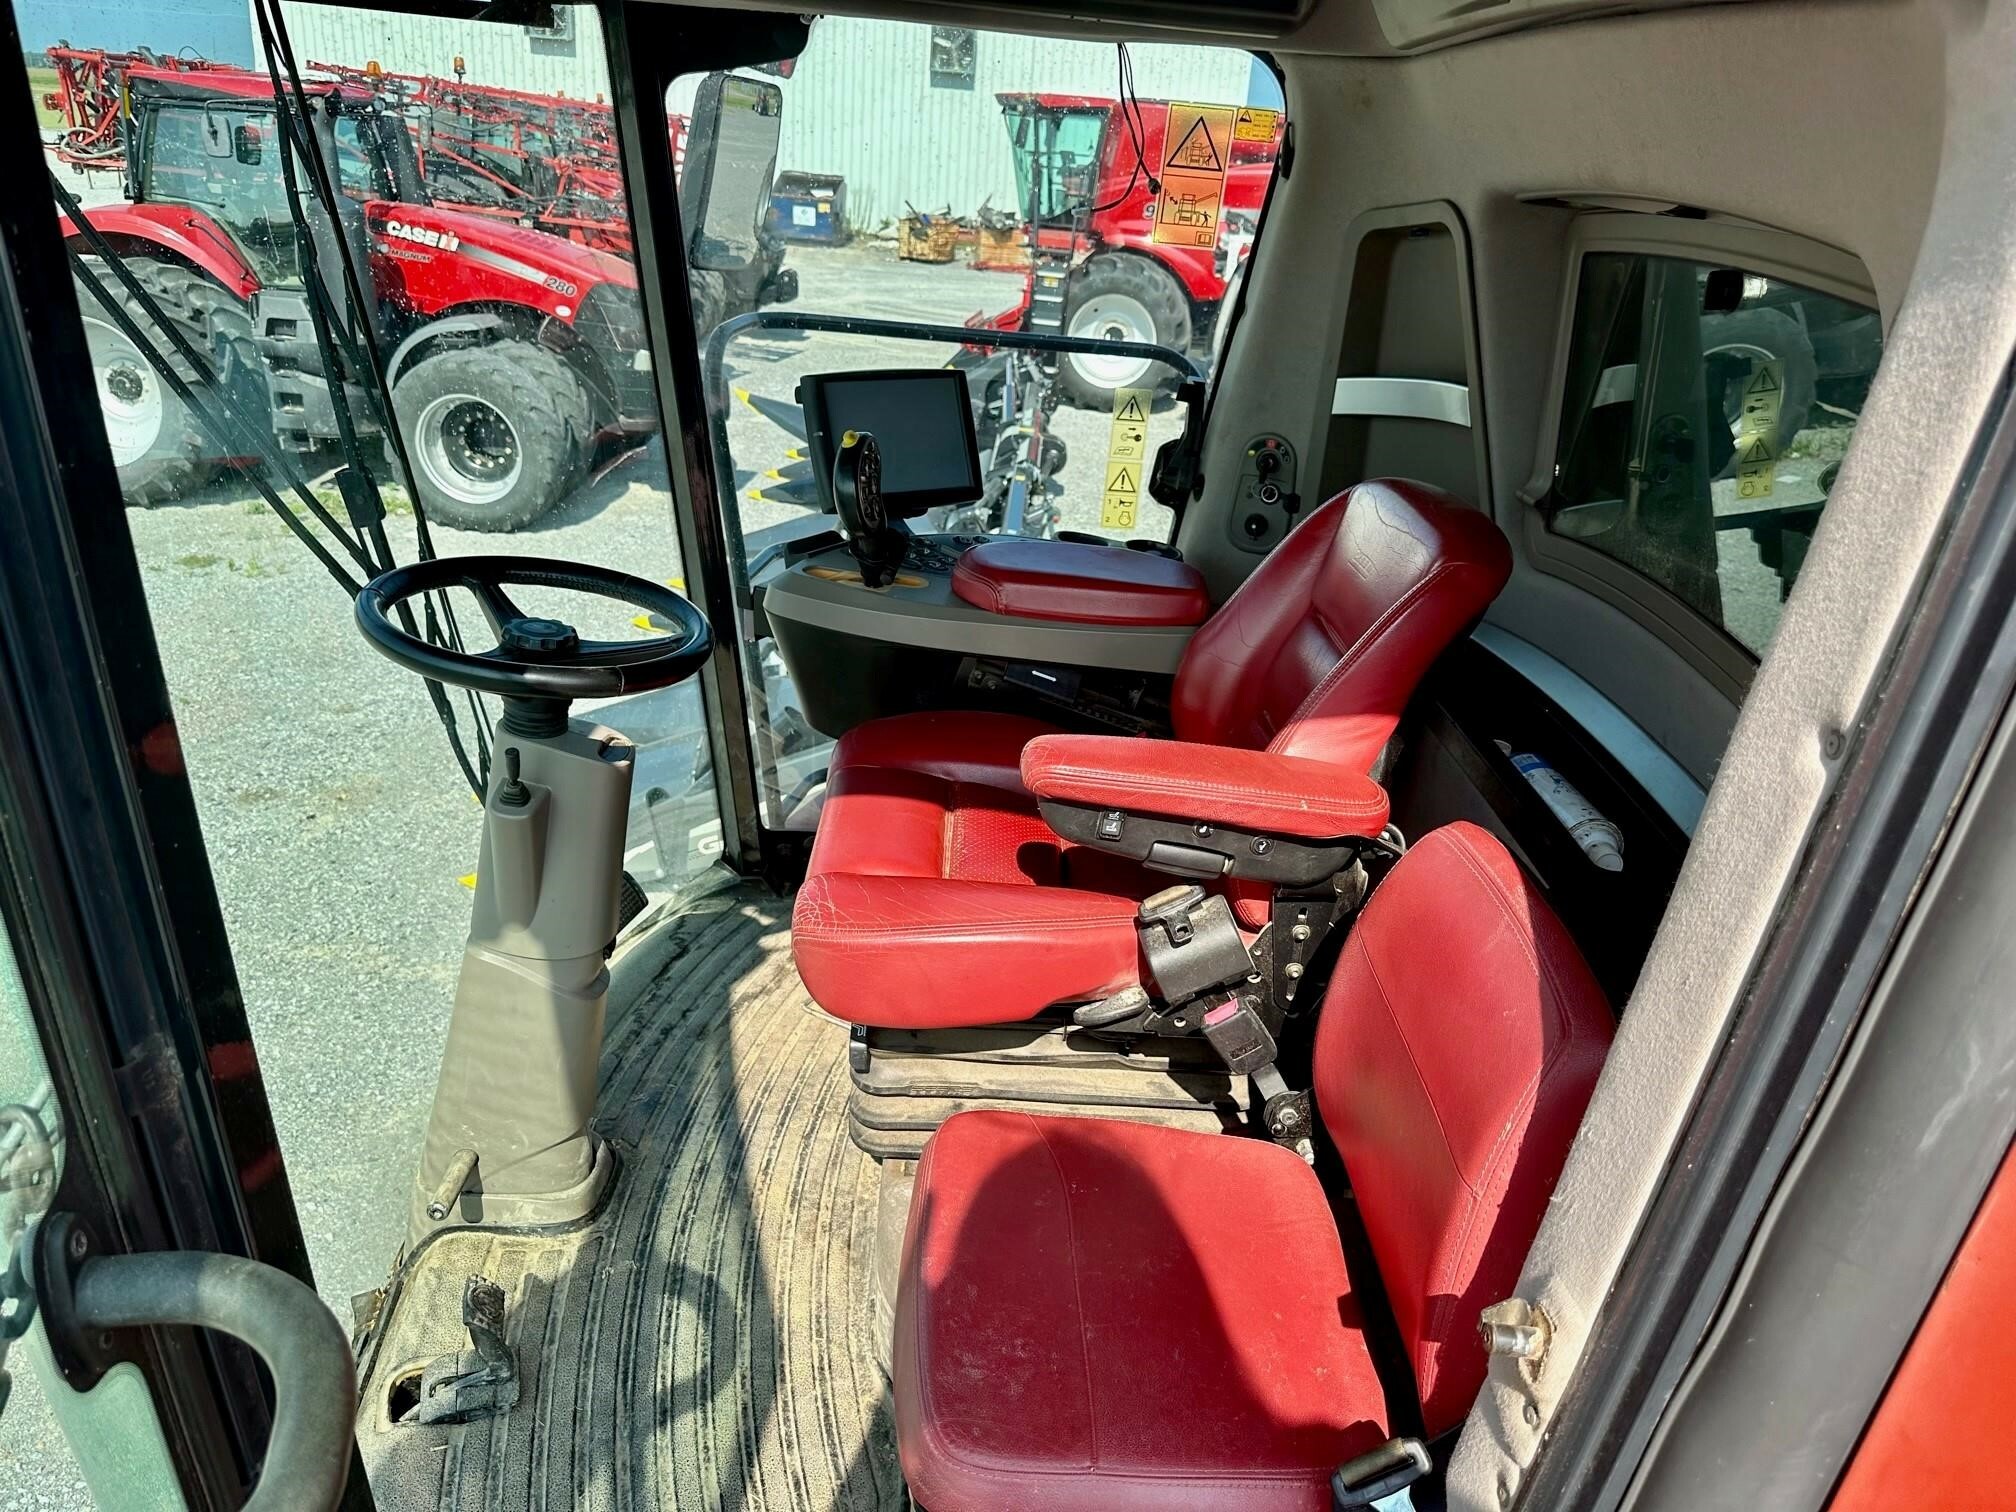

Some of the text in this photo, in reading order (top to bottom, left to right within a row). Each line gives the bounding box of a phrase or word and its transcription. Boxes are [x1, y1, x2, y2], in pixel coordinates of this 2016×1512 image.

[386, 220, 440, 248] CASE
[391, 249, 432, 263] MAGNUM
[545, 276, 577, 297] 280
